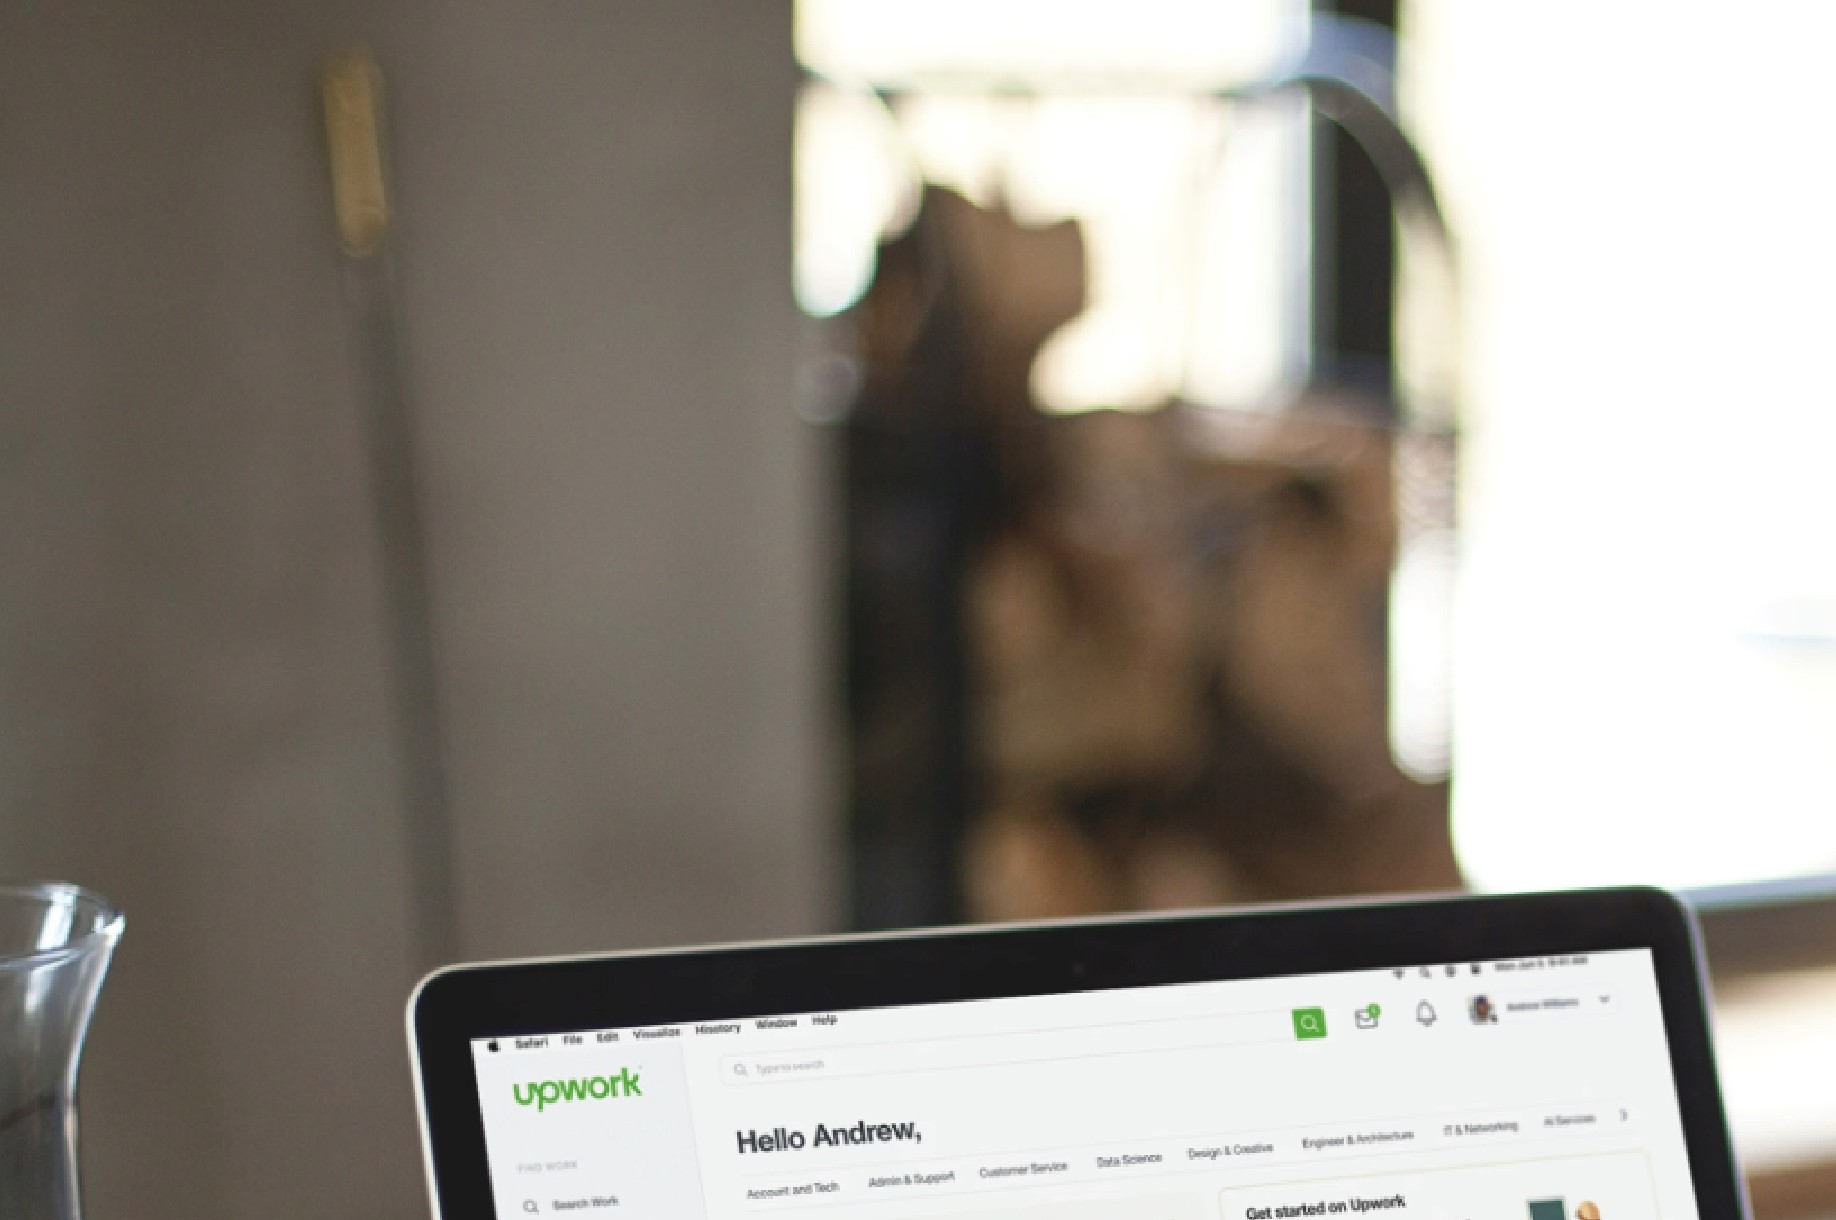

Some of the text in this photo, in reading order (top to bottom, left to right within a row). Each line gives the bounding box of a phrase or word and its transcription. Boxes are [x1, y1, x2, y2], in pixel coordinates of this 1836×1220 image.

[515, 1036, 548, 1048] Safari
[563, 1034, 582, 1044] File
[596, 1032, 618, 1043] Edit
[755, 1018, 797, 1029] Window
[812, 1015, 838, 1025] Help
[513, 1067, 642, 1112] upwork
[737, 1121, 921, 1153] Hello Andrew,
[1301, 1137, 1344, 1151] Engineer
[1189, 1144, 1274, 1160] Design Creative
[1097, 1155, 1162, 1167] Data Science
[980, 1162, 1067, 1178] Customer Service
[869, 1171, 955, 1187] Admin Support
[748, 1183, 840, 1199] Account and Tech
[552, 1196, 618, 1210] Search Work
[1274, 1201, 1326, 1219] started
[1328, 1201, 1346, 1213] on
[1351, 1194, 1405, 1212] Upwork
